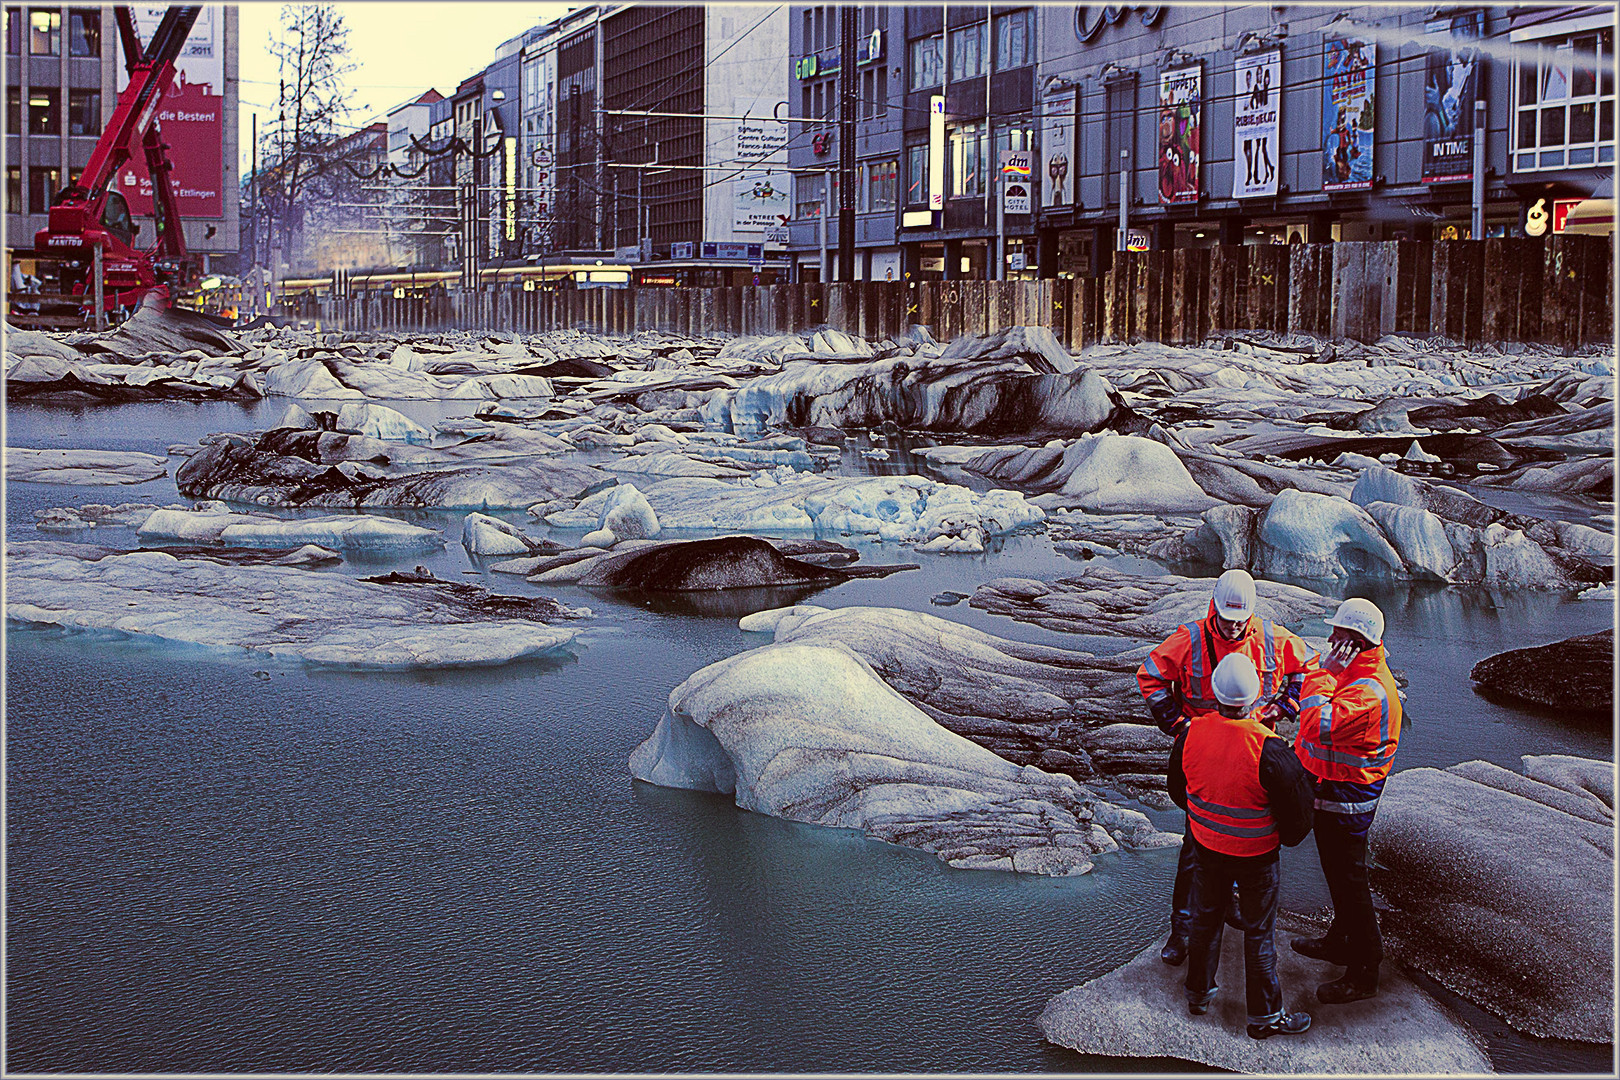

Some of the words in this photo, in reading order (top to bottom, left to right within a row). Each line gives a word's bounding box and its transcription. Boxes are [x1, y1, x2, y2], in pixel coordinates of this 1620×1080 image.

[160, 111, 175, 120] die
[177, 111, 215, 122] Besten!
[1433, 143, 1445, 156] IN
[1445, 140, 1469, 155] TIME
[1008, 154, 1028, 167] dm
[180, 189, 215, 199] Ettlingen
[48, 239, 83, 247] MANITOU
